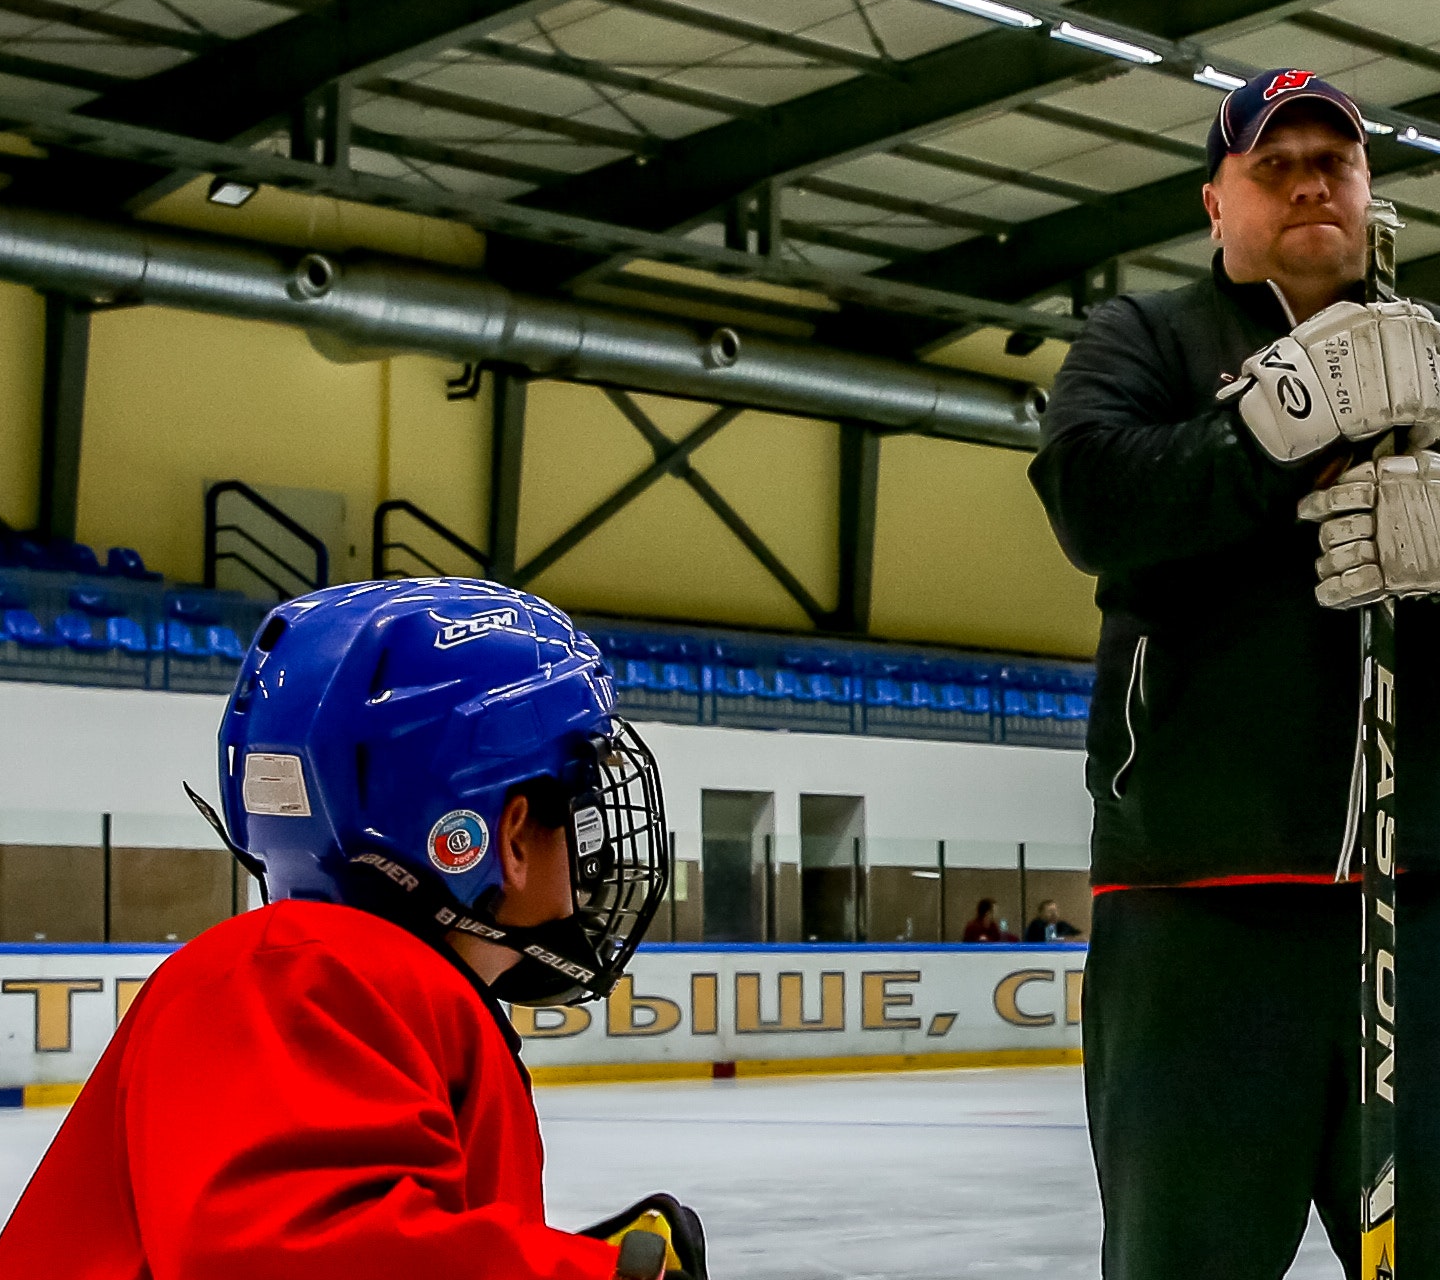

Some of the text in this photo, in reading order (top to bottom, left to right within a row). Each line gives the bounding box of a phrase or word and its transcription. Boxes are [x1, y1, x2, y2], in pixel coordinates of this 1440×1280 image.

[439, 609, 514, 641] CCM
[350, 853, 420, 892] AUER
[434, 906, 507, 940] BUER
[523, 943, 596, 984] BAUER
[993, 968, 1083, 1026] С
